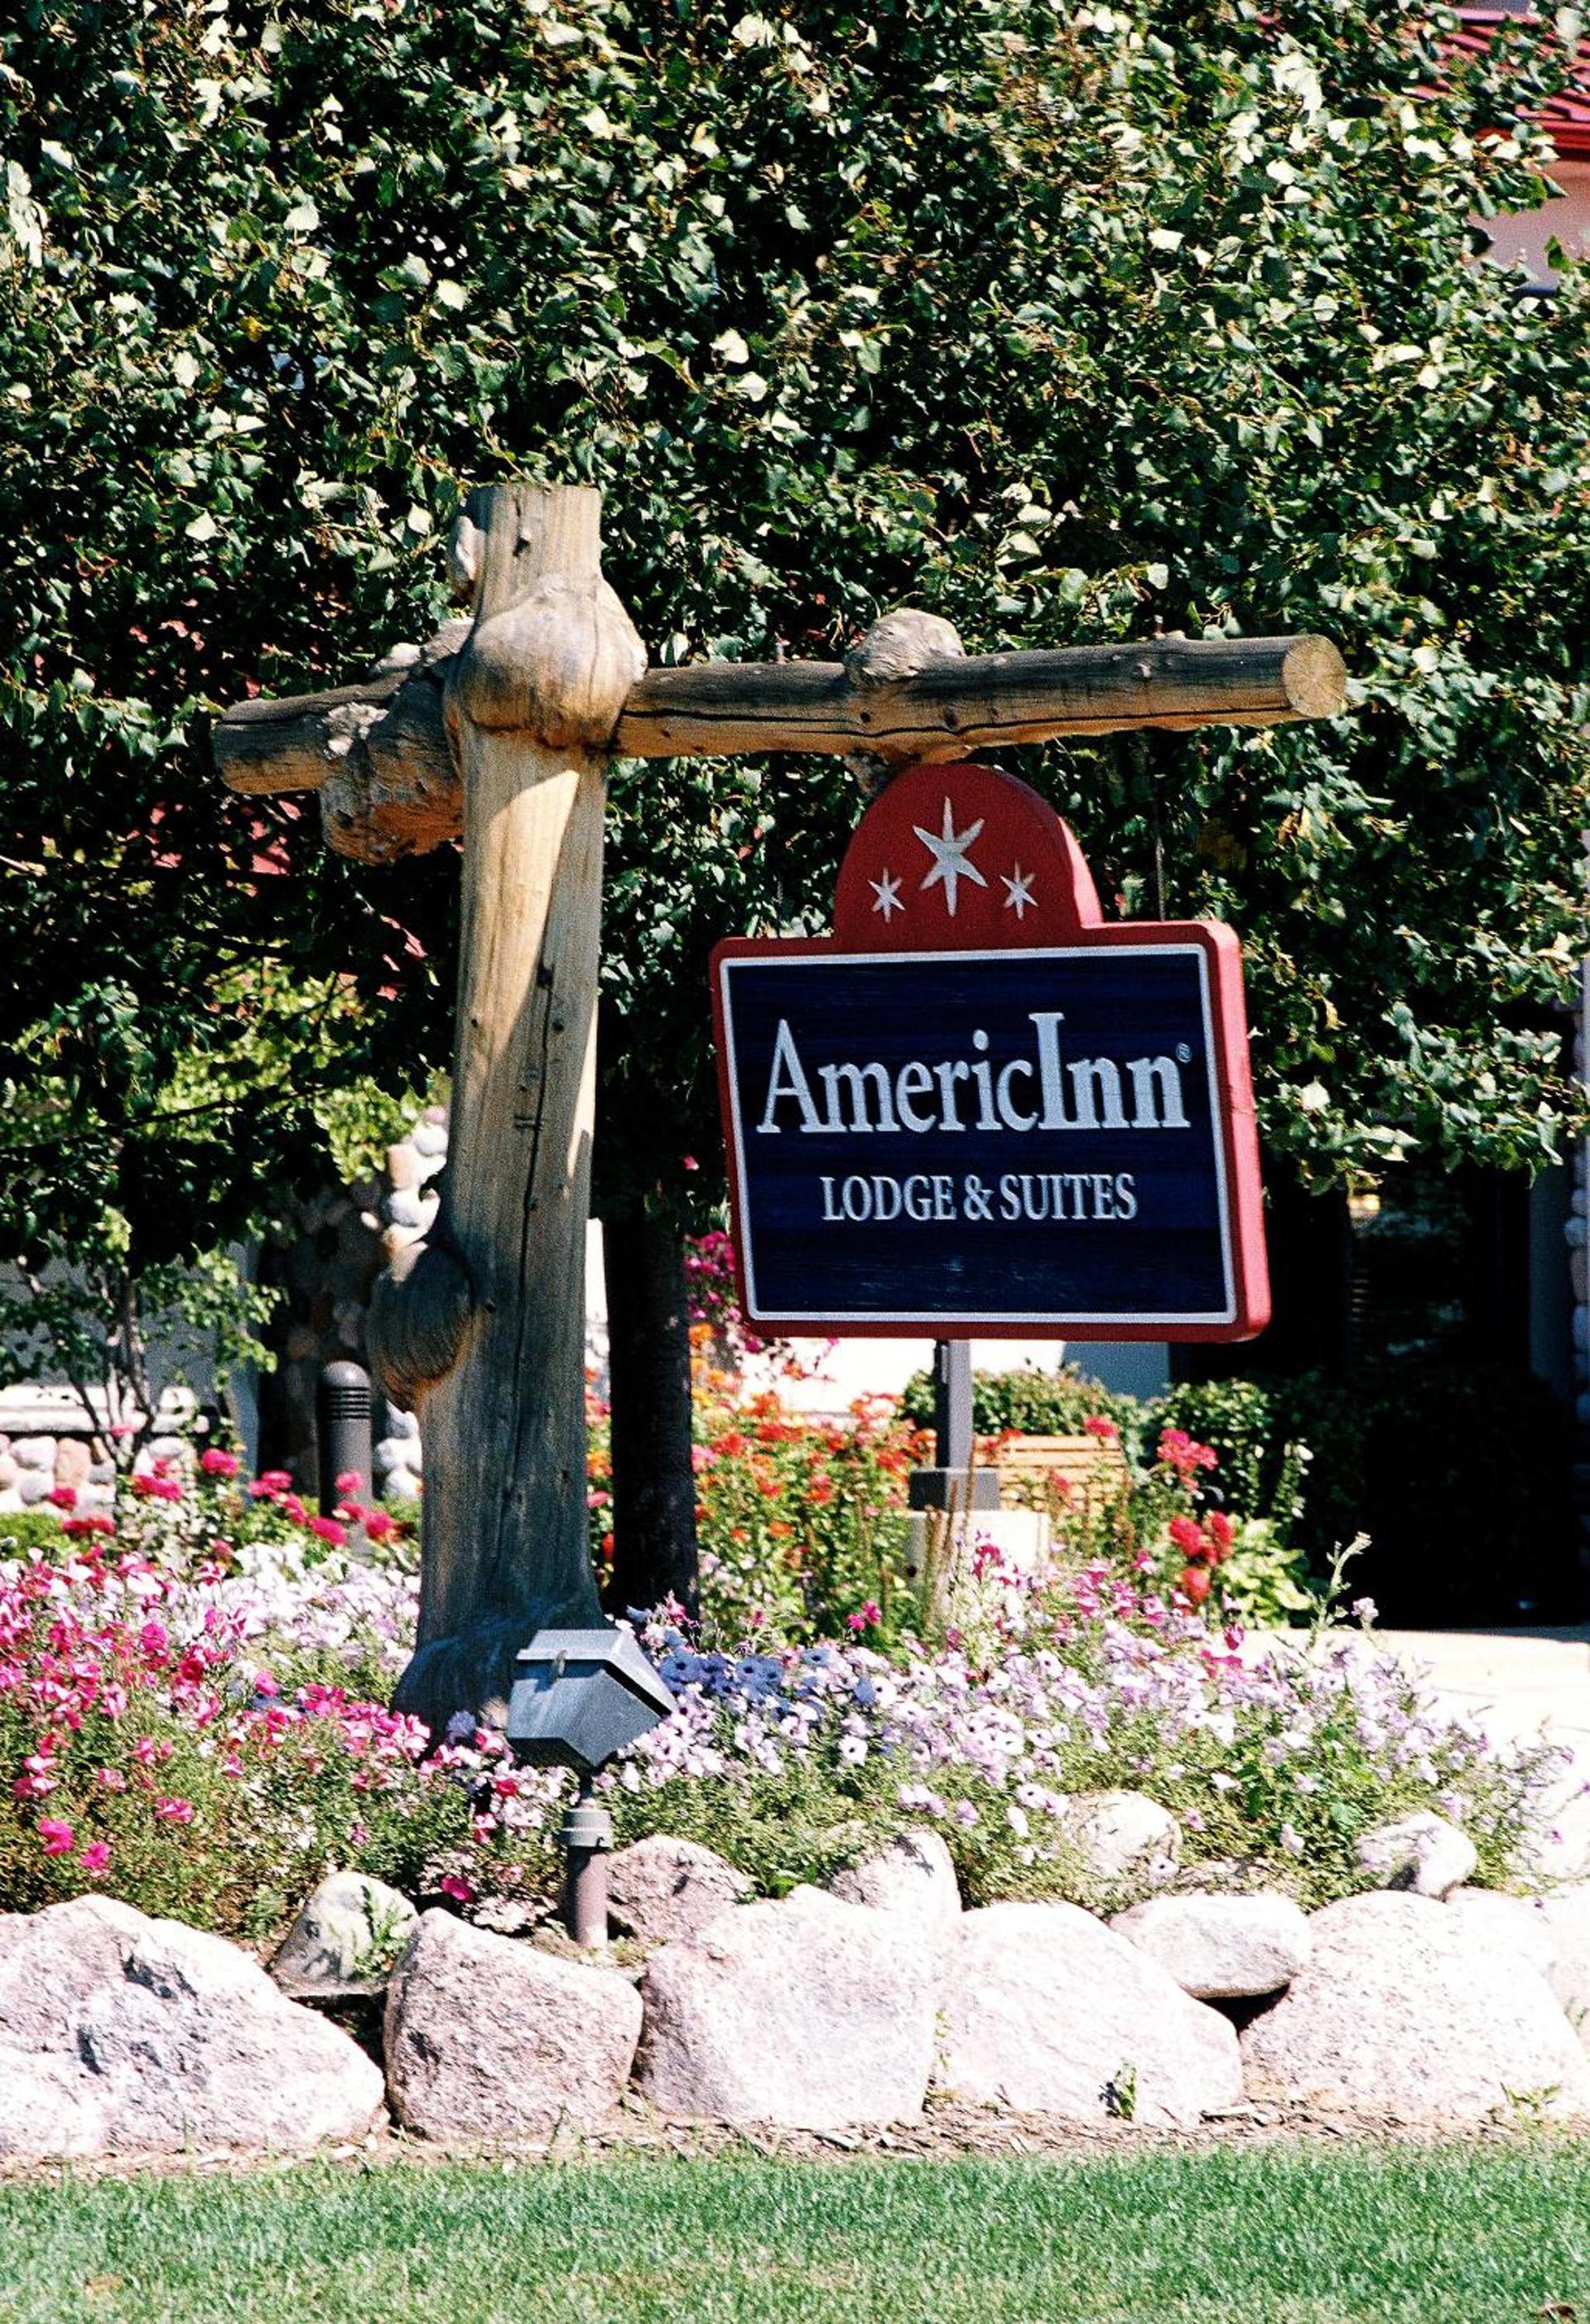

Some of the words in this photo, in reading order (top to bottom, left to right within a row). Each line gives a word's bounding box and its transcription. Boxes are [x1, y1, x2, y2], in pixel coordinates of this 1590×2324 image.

[820, 1175, 956, 1221] LODGE
[964, 1174, 995, 1221] &
[1000, 1172, 1138, 1220] SUITES
